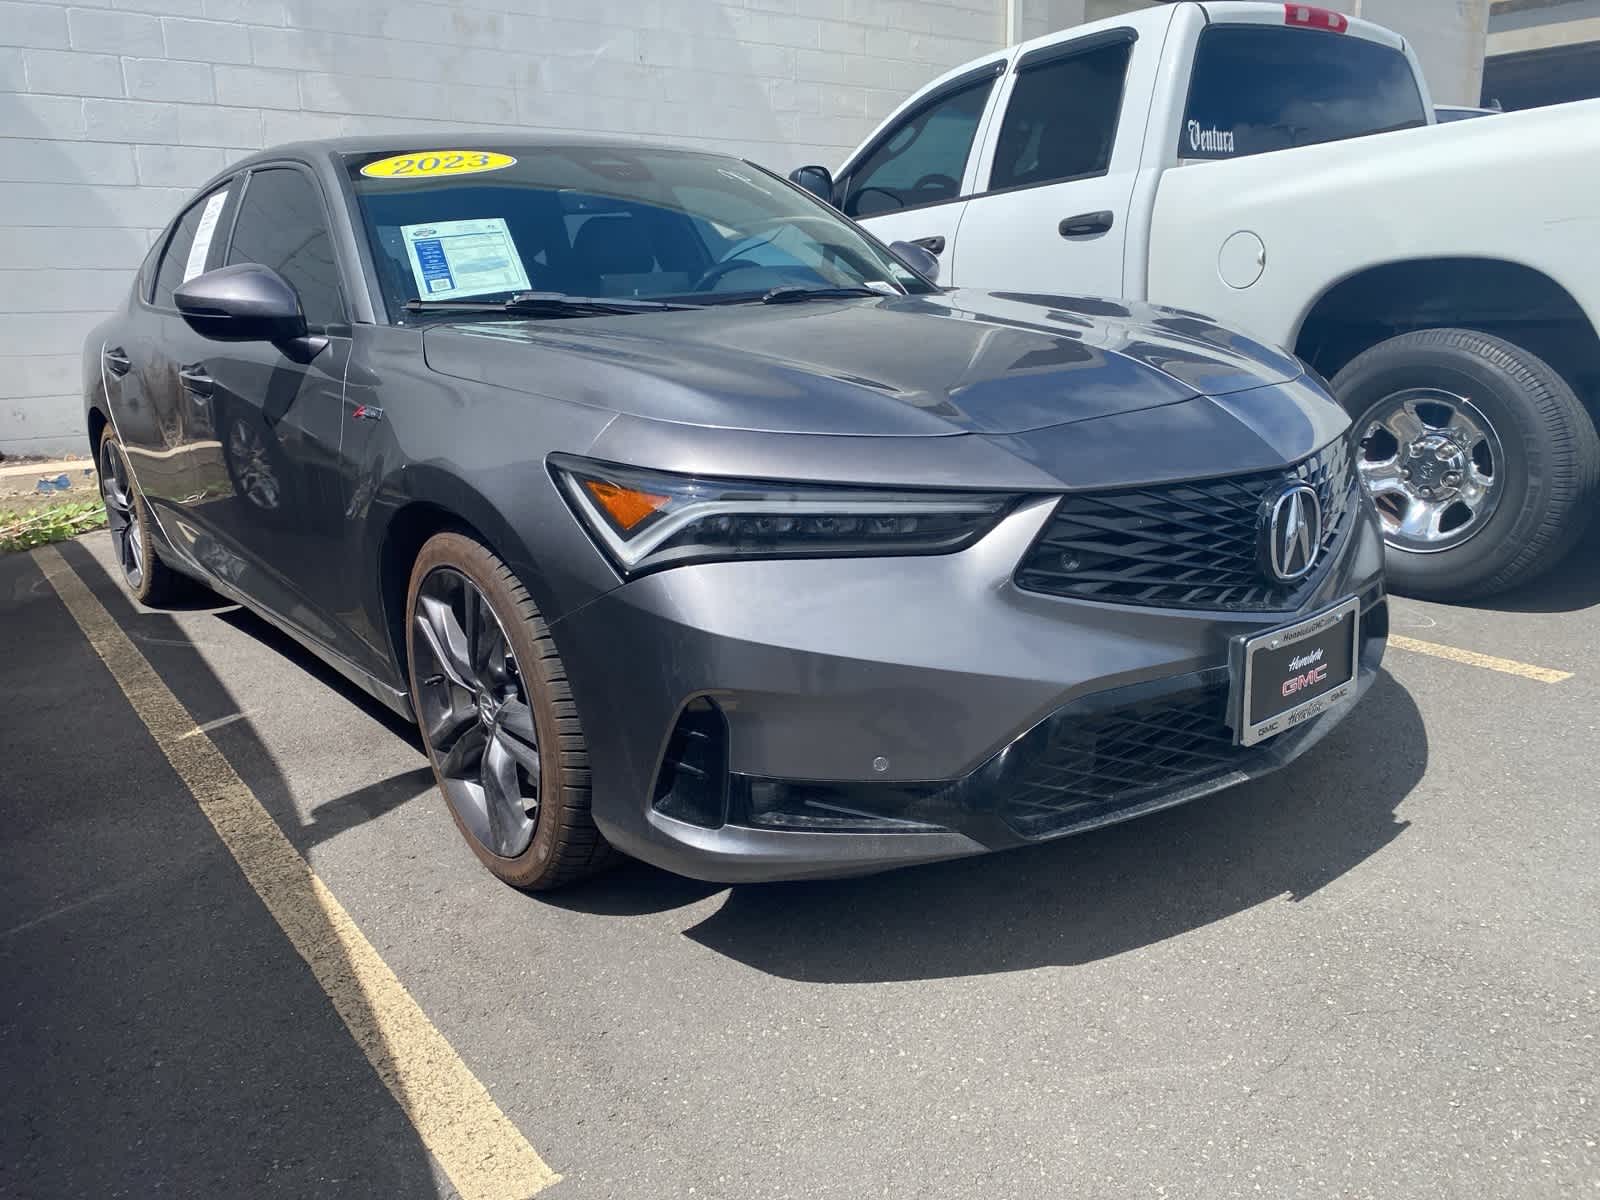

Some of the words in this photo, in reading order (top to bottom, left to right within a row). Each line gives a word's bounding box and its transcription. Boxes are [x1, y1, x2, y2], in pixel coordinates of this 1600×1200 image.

[1188, 119, 1234, 152] Ventura
[392, 154, 490, 175] 2023
[1282, 663, 1327, 696] GMC
[1257, 721, 1279, 736] GMC
